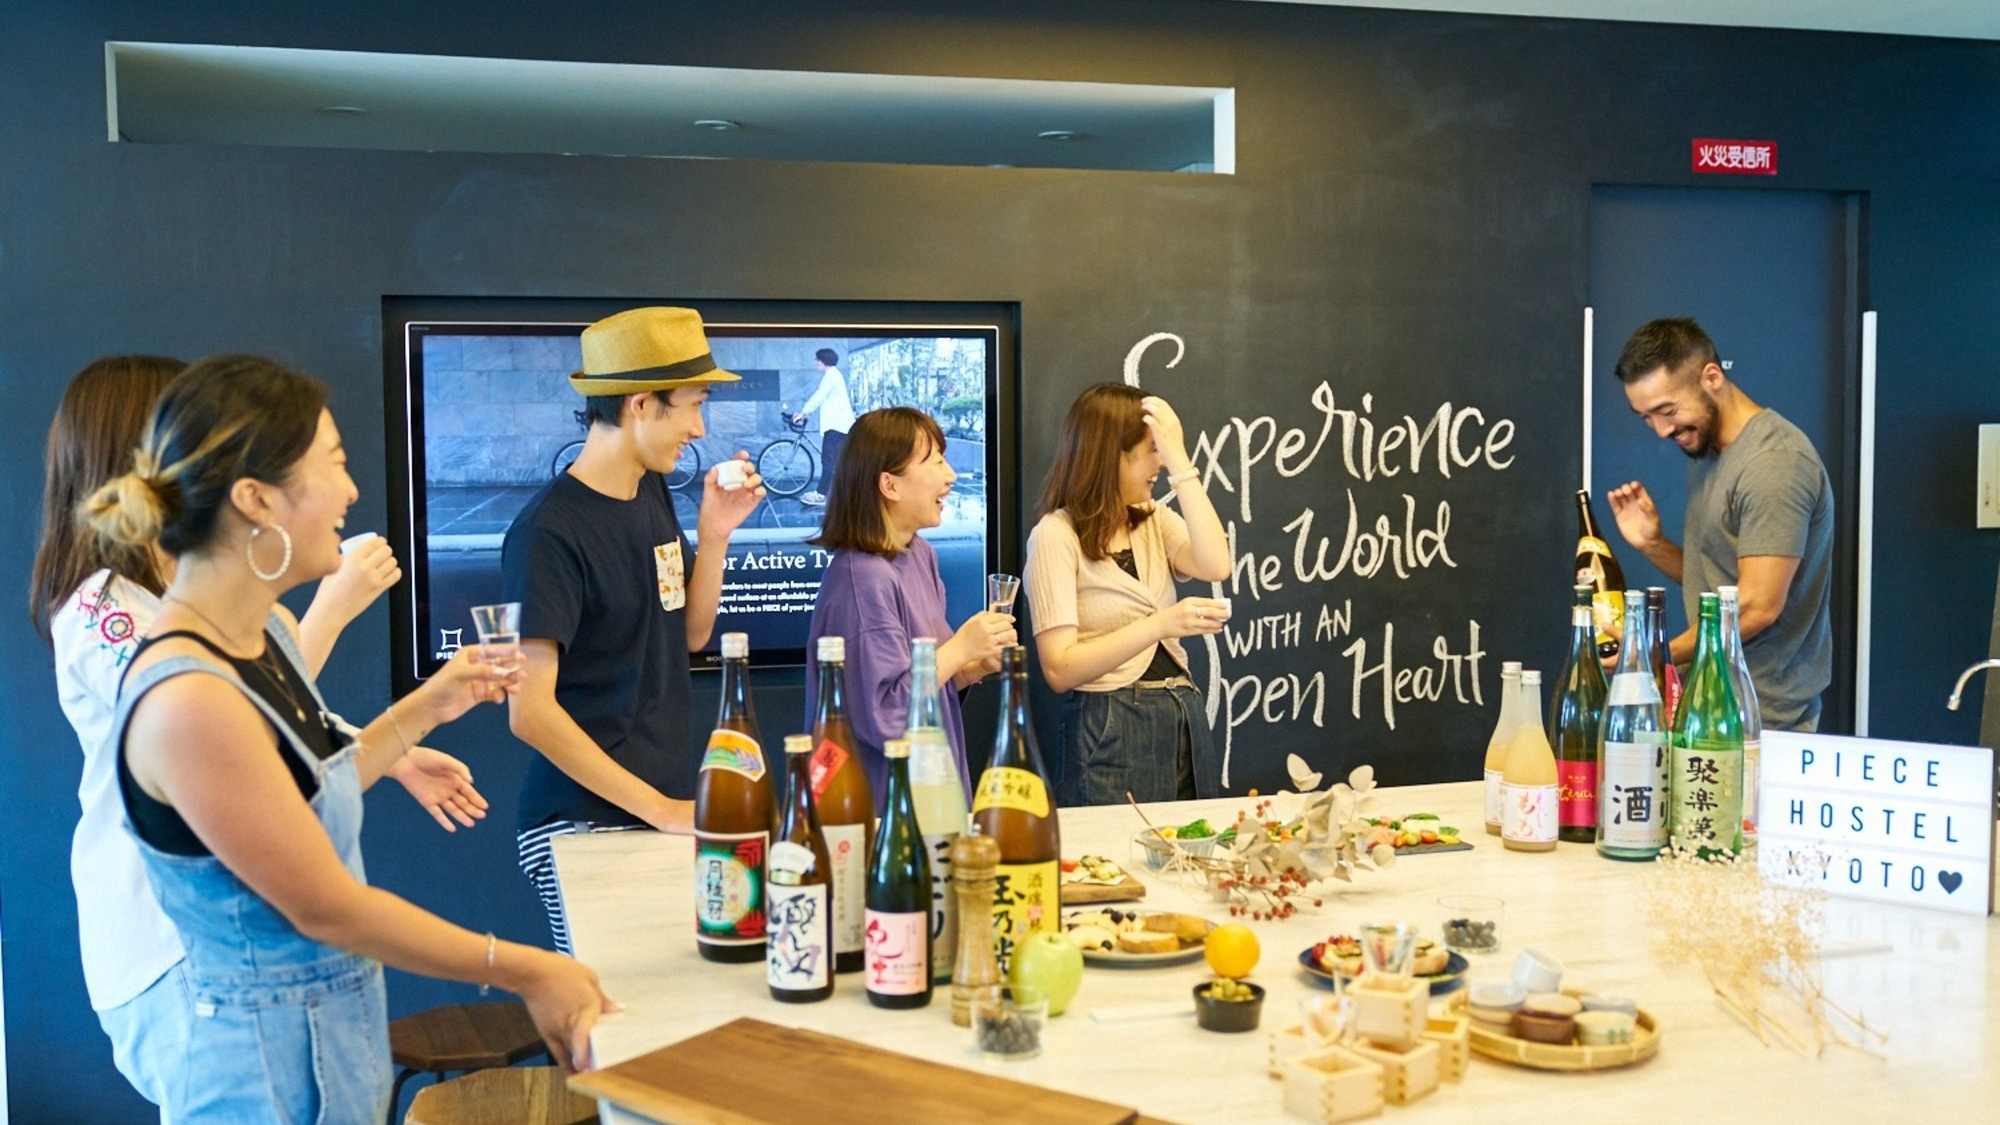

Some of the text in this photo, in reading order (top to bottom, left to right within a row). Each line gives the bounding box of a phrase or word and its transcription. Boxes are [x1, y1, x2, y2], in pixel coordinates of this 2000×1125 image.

[1699, 145, 1771, 169] 火災受信所
[721, 556, 738, 570] or
[741, 550, 806, 570] Active
[1213, 488, 1458, 600] he World
[1224, 599, 1352, 658] WITH AN
[436, 651, 458, 660] PIE
[1342, 620, 1486, 730] Heart
[1801, 749, 1940, 787] PIECE
[1612, 784, 1653, 825] 酒
[1790, 799, 1958, 843] HOSTEL
